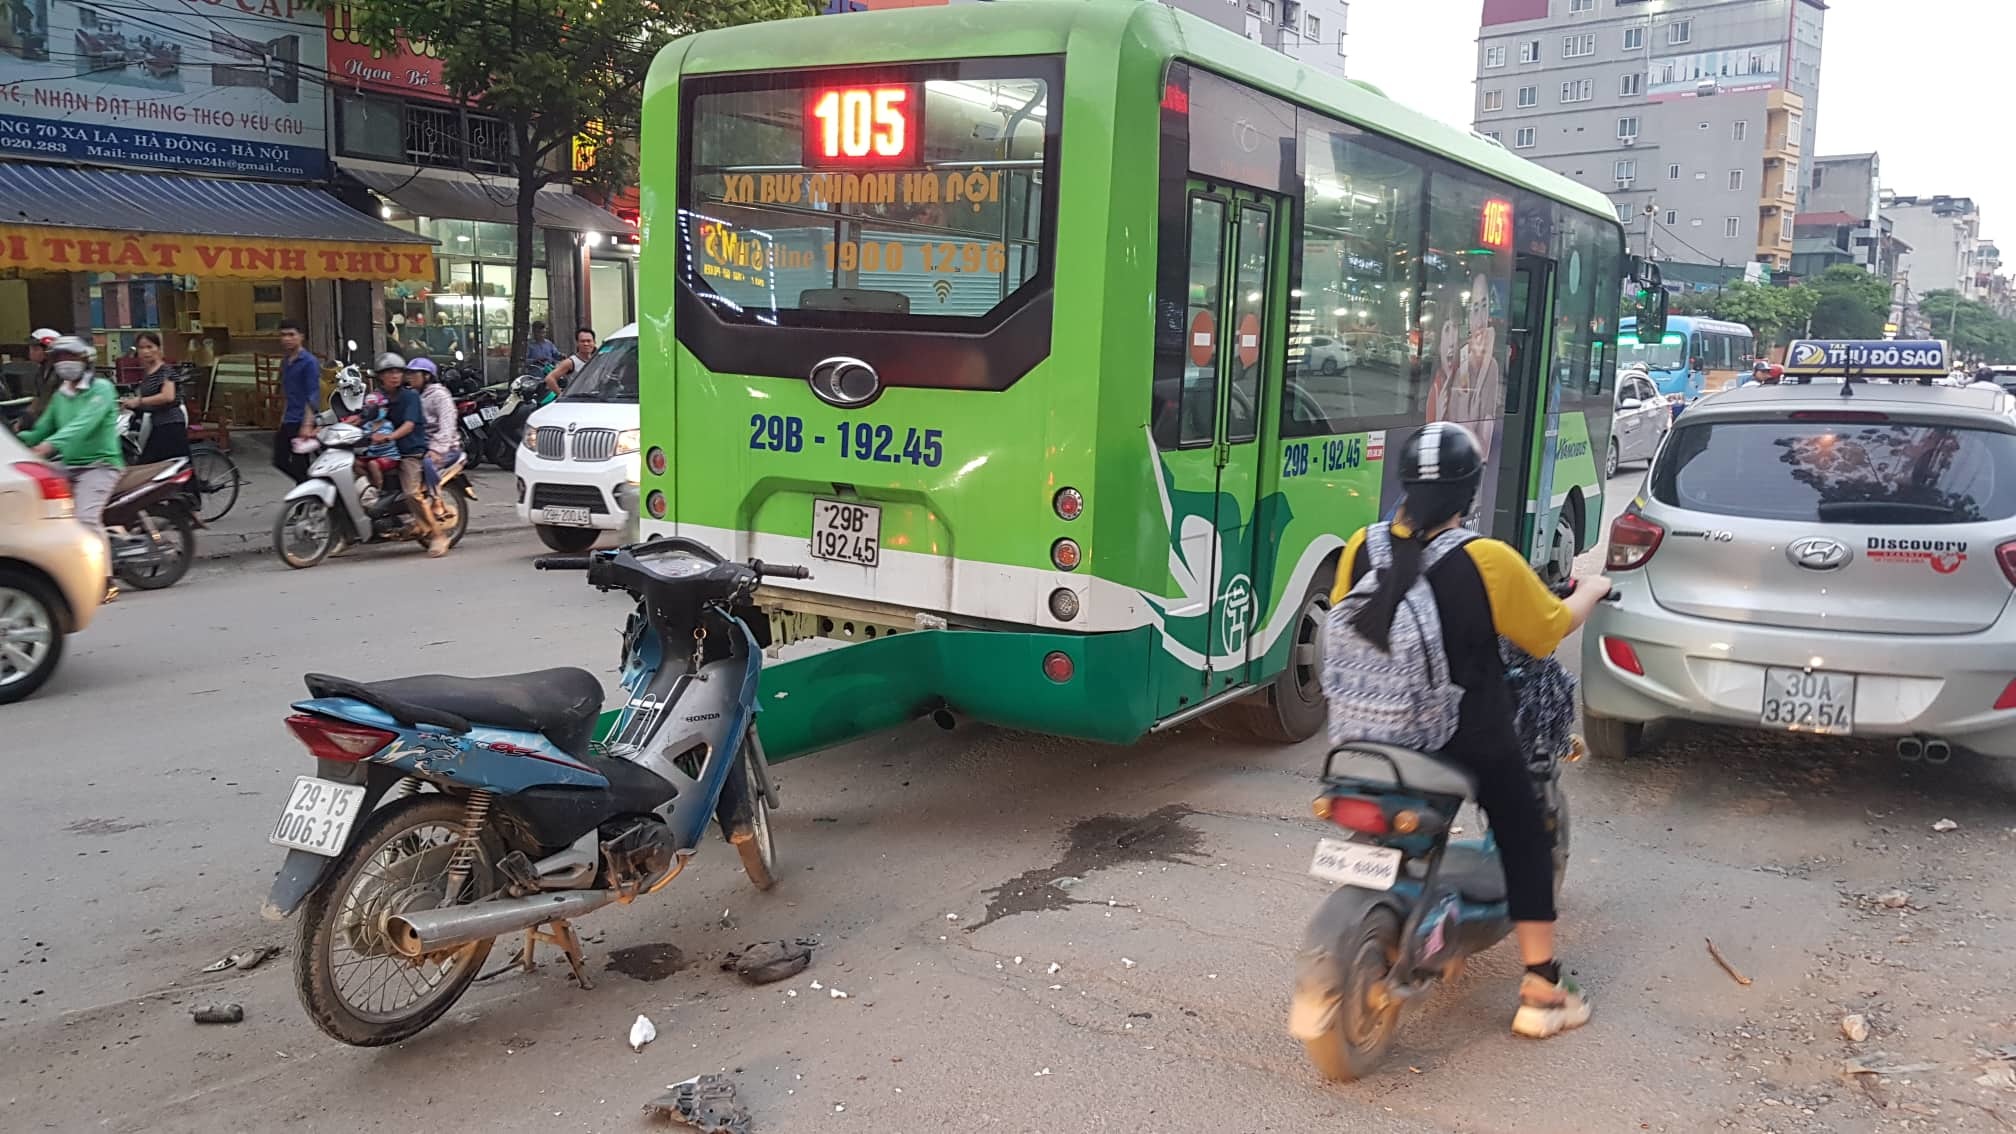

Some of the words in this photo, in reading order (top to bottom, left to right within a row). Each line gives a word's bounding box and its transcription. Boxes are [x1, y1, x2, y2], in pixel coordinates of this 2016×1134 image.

[192, 107, 235, 127] THEO
[814, 89, 906, 157] 105
[36, 123, 58, 137] 70
[61, 126, 88, 141] XA
[94, 130, 118, 144] LA
[134, 132, 161, 149] HÀ
[165, 136, 217, 153] ĐÔNG
[231, 142, 255, 158] HÀ
[260, 145, 290, 162] NỘI
[87, 145, 126, 159] Mail:
[130, 150, 304, 175] noithat.vn24h@gmail.com
[760, 174, 803, 204] BUS
[808, 173, 896, 204] NHANH
[903, 165, 939, 204] HÀ
[945, 165, 1003, 213] NỘI
[1483, 200, 1504, 246] 105
[42, 236, 182, 268] THẤT
[196, 245, 307, 272] VINH
[319, 246, 428, 274] THÙY
[823, 240, 904, 273] 1900
[919, 241, 1006, 274] 1296
[1870, 346, 1900, 366] ĐÔ
[1901, 349, 1942, 366] SAO
[750, 413, 803, 453] 29B
[837, 421, 943, 468] 192.45
[1283, 443, 1309, 478] 29B
[1322, 438, 1361, 473] 192.45
[828, 504, 864, 532] 29B
[816, 530, 876, 563] 192.45
[1867, 537, 1967, 552] Discovery
[1786, 673, 1832, 702] 30A
[686, 712, 720, 722] HONDA
[278, 812, 345, 850] 006.31
